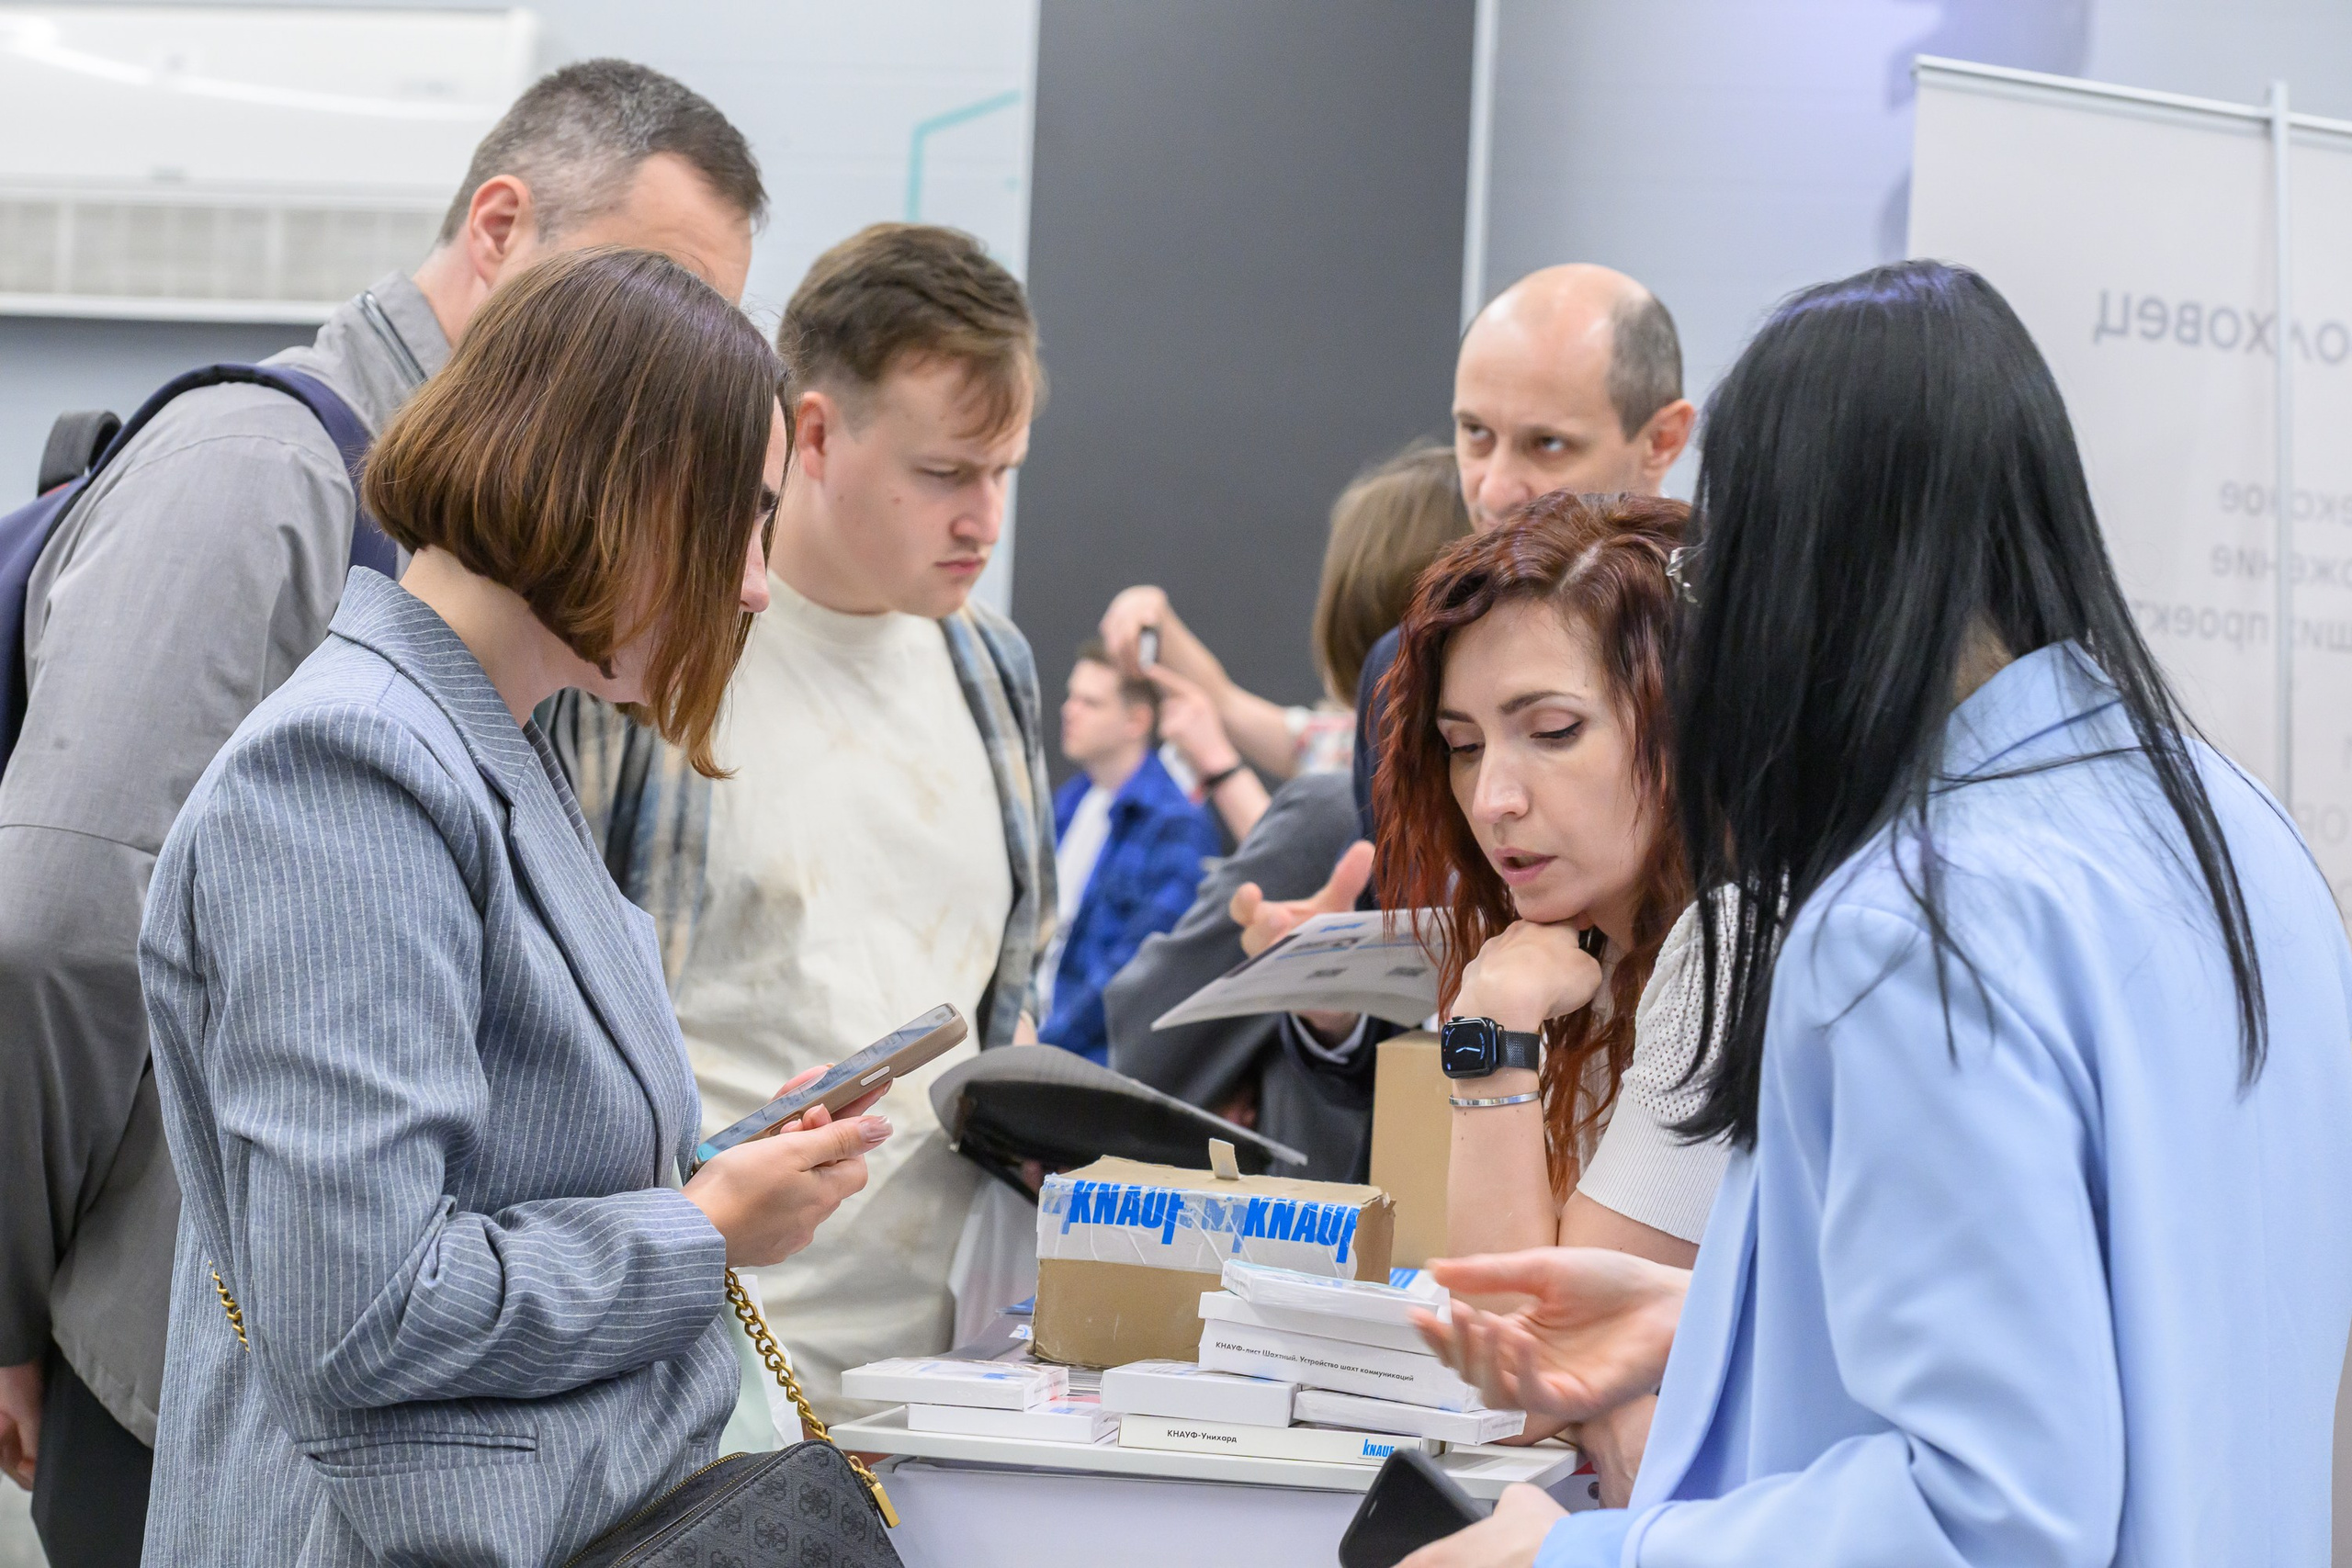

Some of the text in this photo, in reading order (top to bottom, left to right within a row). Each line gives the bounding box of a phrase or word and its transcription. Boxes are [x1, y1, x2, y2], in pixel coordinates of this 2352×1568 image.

[1069, 1179, 1185, 1246] KNAUF
[1215, 1341, 1414, 1382] КНАУФ-лист Шахтный. Устройство шахт коммуникаций
[1167, 1429, 1238, 1444] КНАУФ-Унихард
